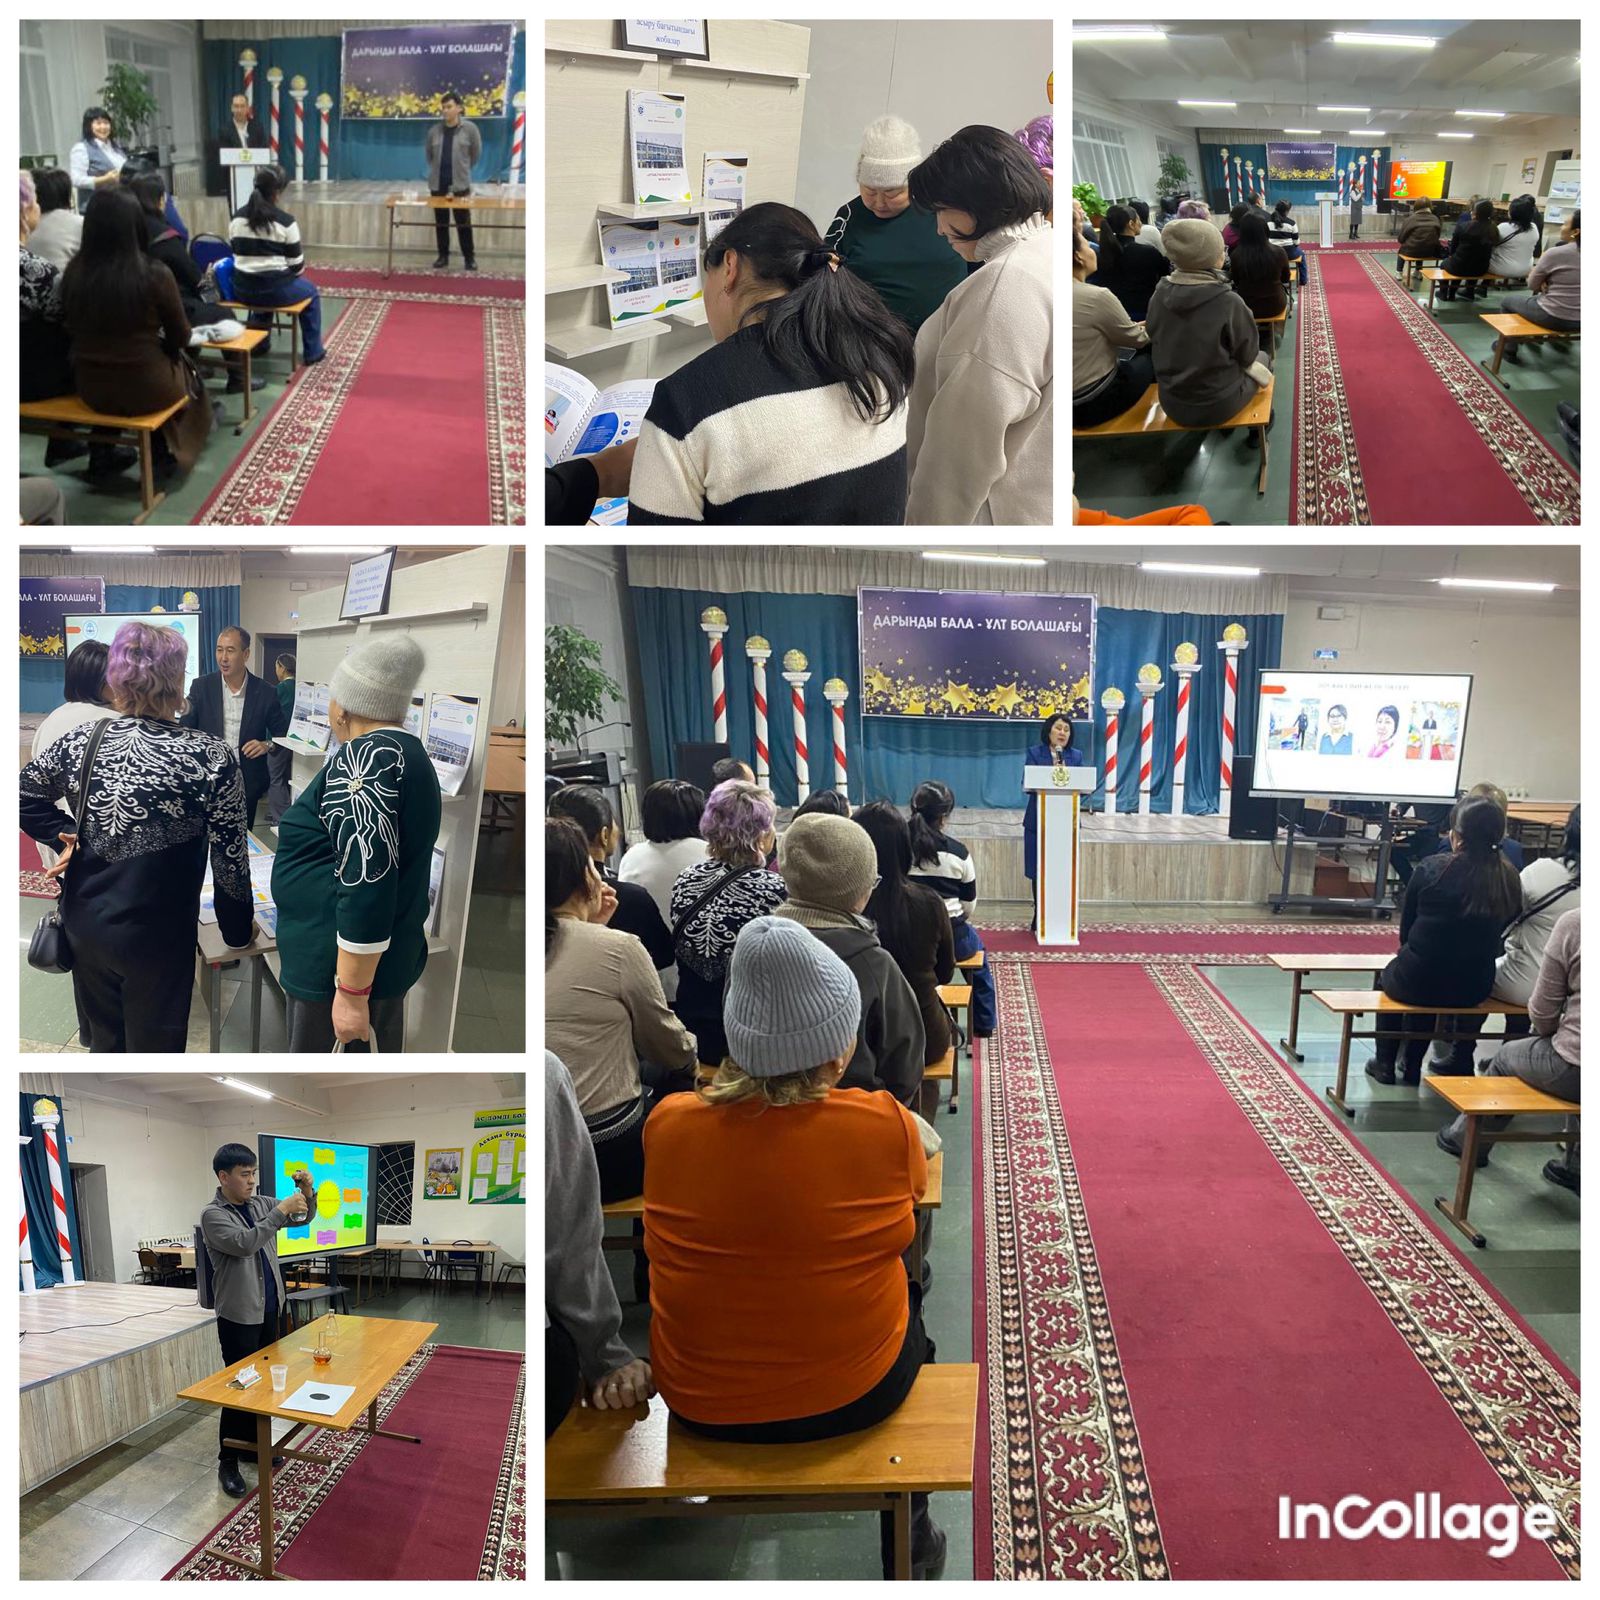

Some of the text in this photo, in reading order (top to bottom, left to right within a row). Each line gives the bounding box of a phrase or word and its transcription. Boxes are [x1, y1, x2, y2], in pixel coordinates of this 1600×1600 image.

[397, 45, 422, 55] БАЛА
[38, 594, 51, 602] ҰЛТ
[53, 593, 97, 602] БОЛАШАҒЫ
[872, 615, 938, 630] ДАРЫНДЫ
[940, 617, 975, 630] БАЛА
[985, 618, 1007, 631] ҰЛТ
[1010, 619, 1083, 633] БОЛАШАҒЫ
